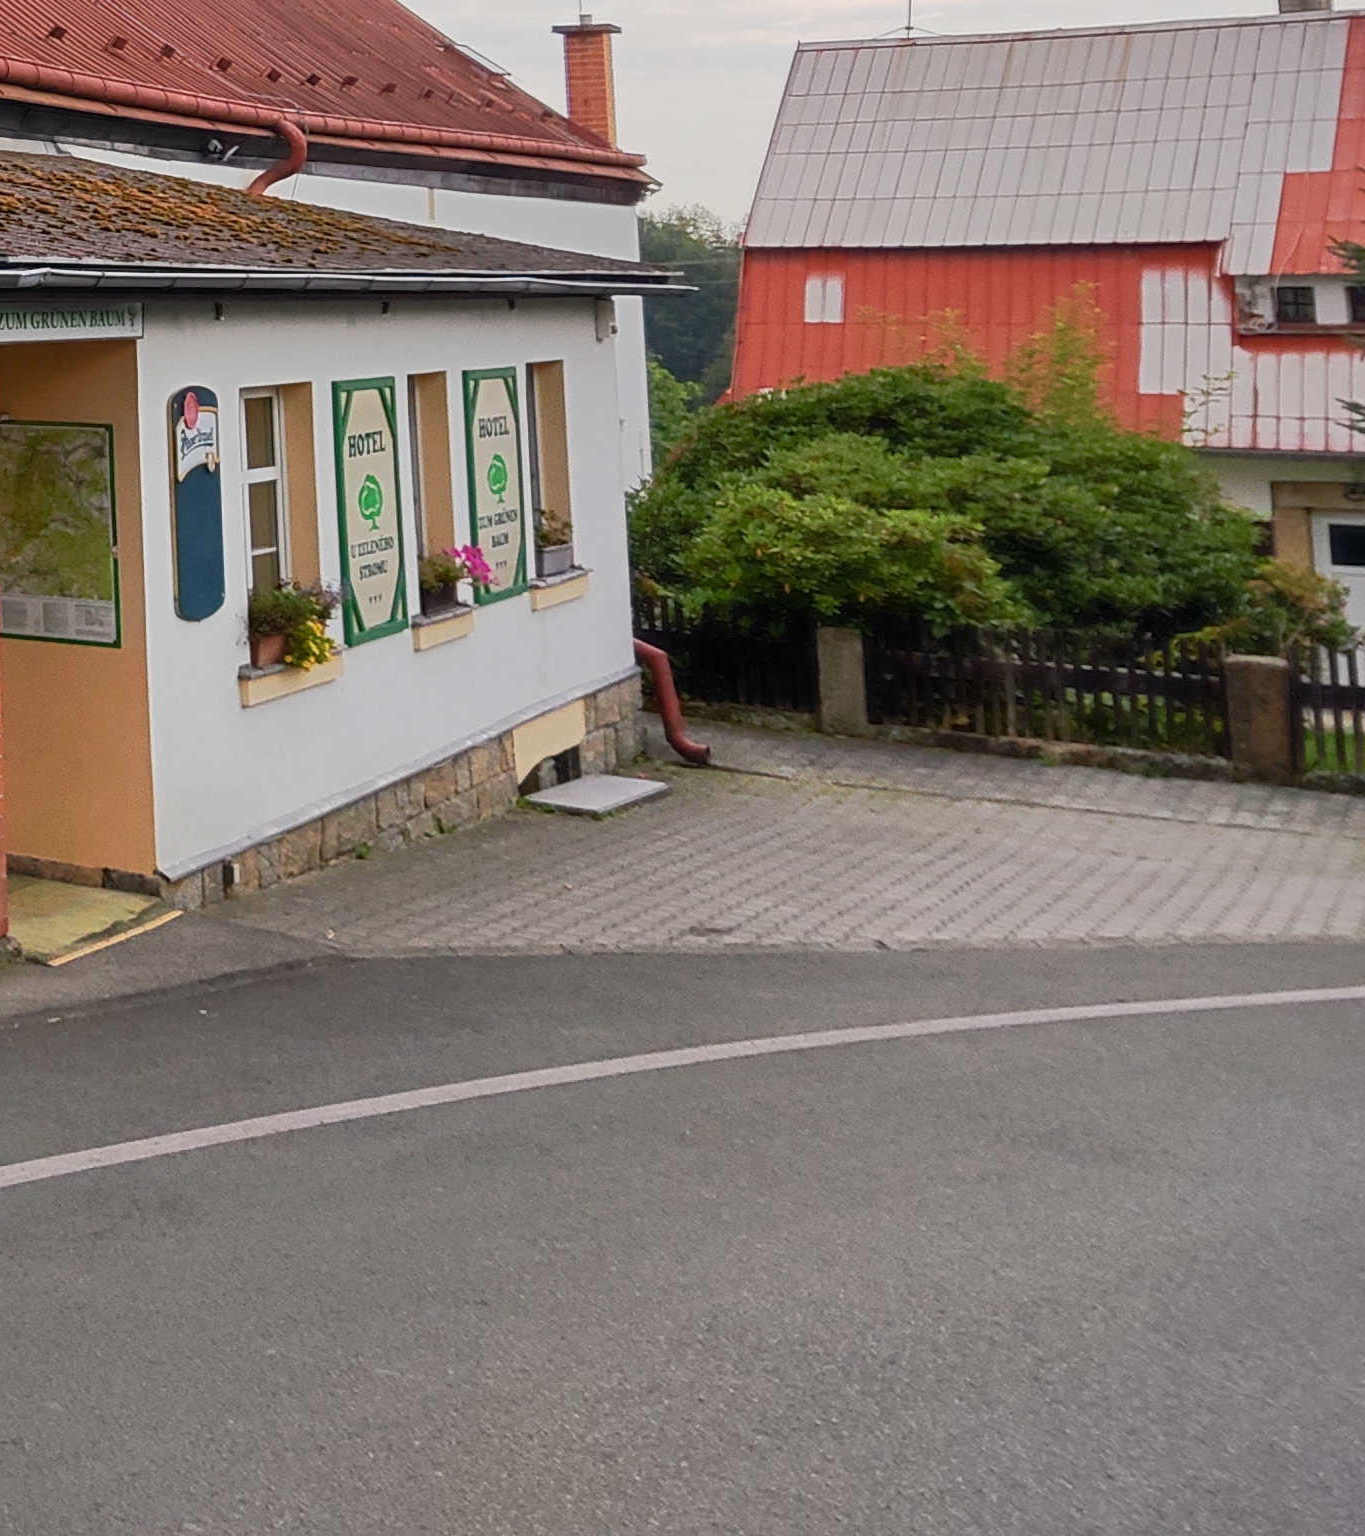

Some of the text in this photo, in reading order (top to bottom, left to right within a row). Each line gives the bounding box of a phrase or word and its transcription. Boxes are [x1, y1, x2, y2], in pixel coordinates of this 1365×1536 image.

[31, 308, 88, 331] GRÜNEN
[90, 309, 126, 328] BAUM
[478, 415, 510, 439] HOTEL
[348, 430, 386, 458] HOTEL
